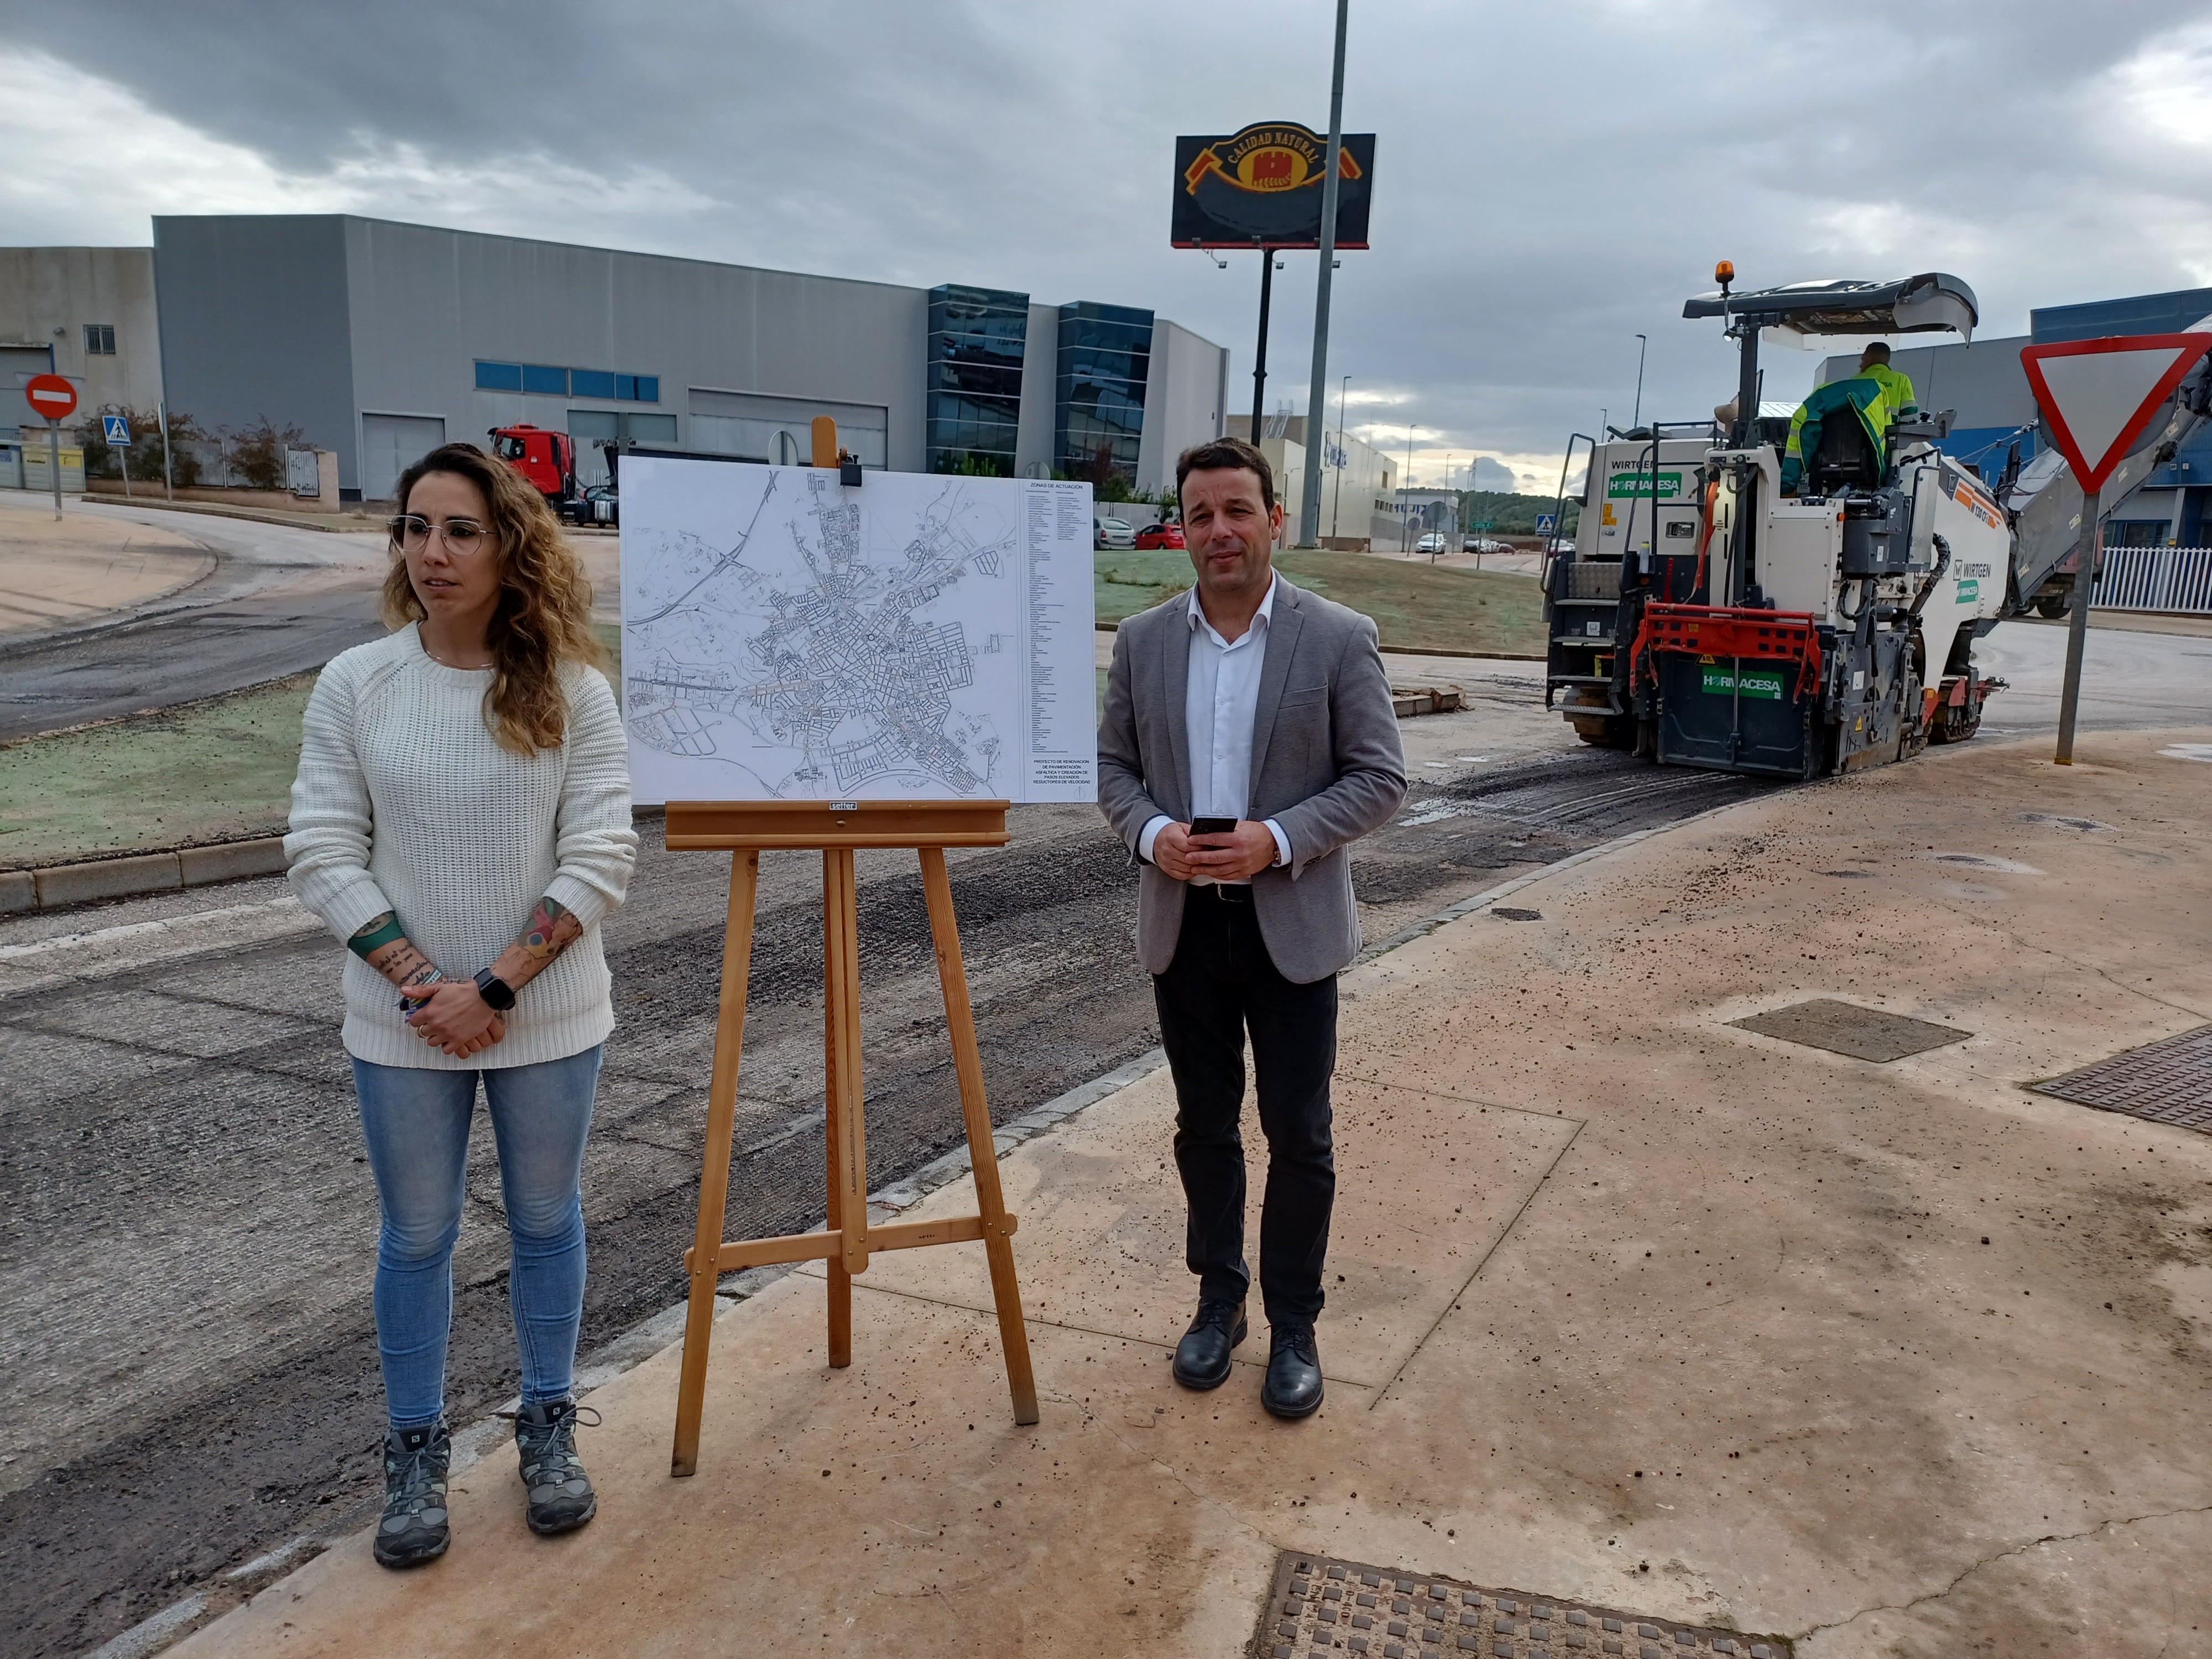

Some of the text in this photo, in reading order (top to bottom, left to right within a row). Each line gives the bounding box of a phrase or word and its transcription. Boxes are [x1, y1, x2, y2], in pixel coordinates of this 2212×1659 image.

[1228, 132, 1319, 164] CALIDAD NATURAL
[1964, 563, 1991, 578] WIRTGEN
